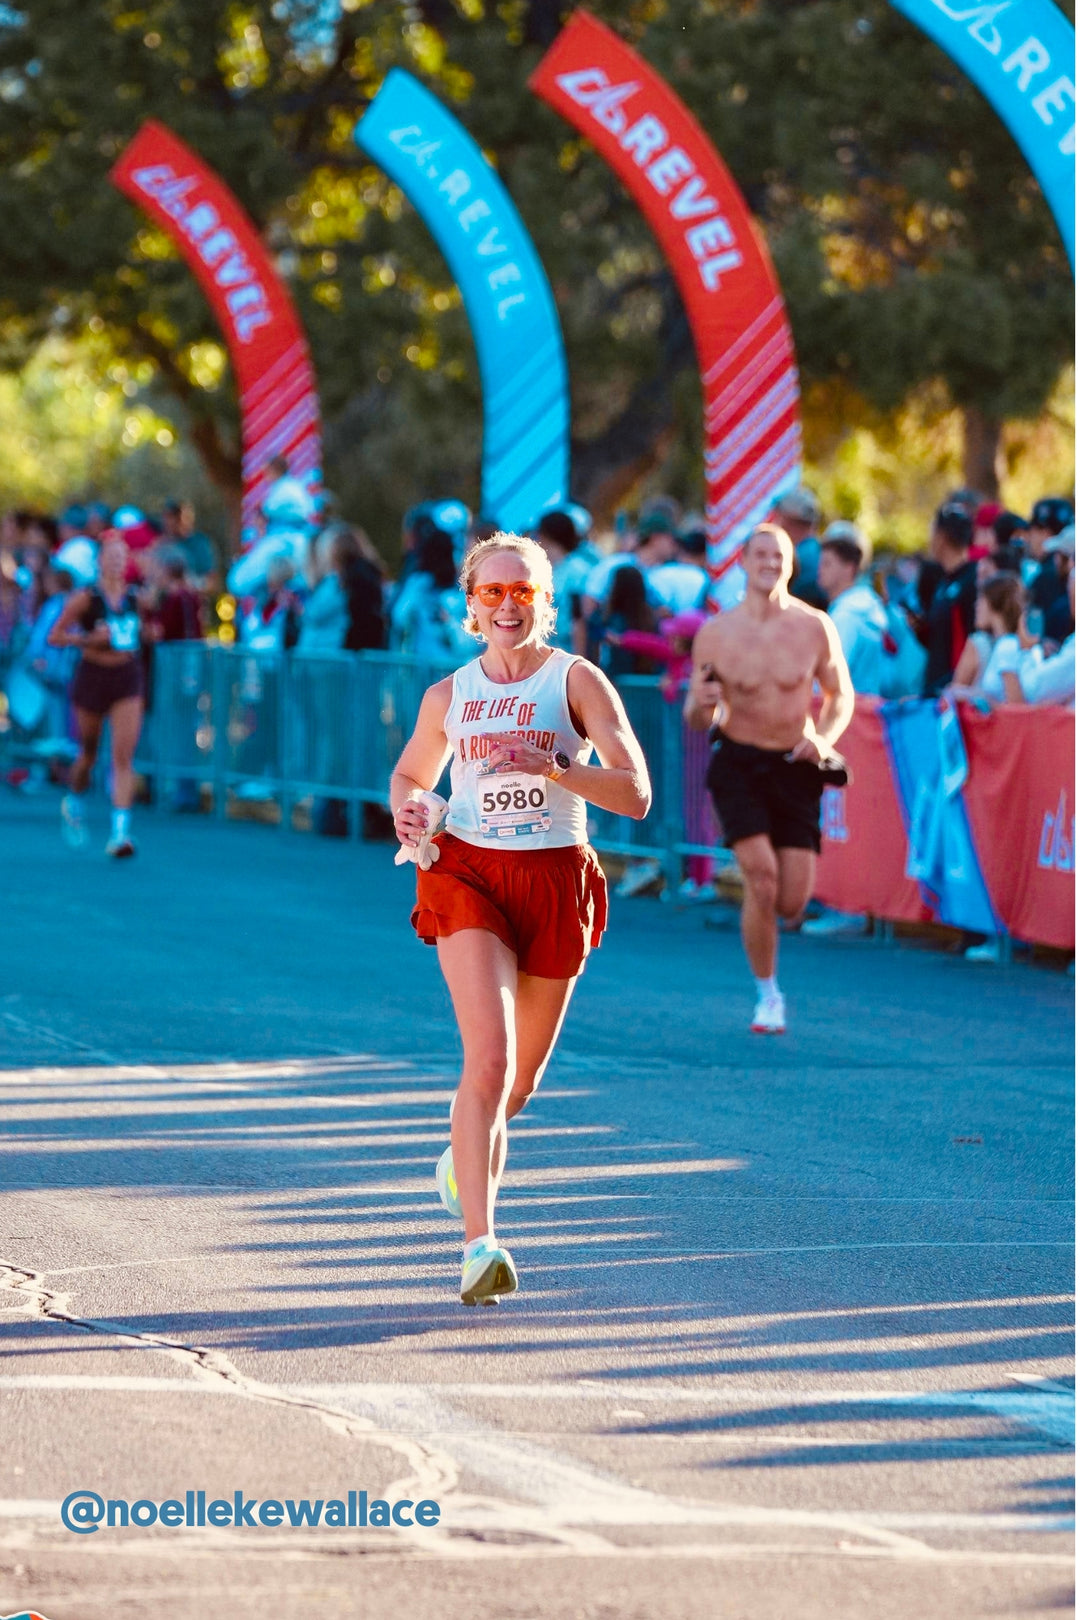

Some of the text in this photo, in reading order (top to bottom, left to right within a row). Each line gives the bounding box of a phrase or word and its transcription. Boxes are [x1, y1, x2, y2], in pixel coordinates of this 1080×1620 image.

[439, 169, 525, 320] REVEL
[620, 113, 742, 292] REVEL
[181, 202, 272, 343] REVEL
[459, 738, 467, 763] A
[461, 696, 537, 727] THE LIFE OF
[483, 788, 544, 813] 5980
